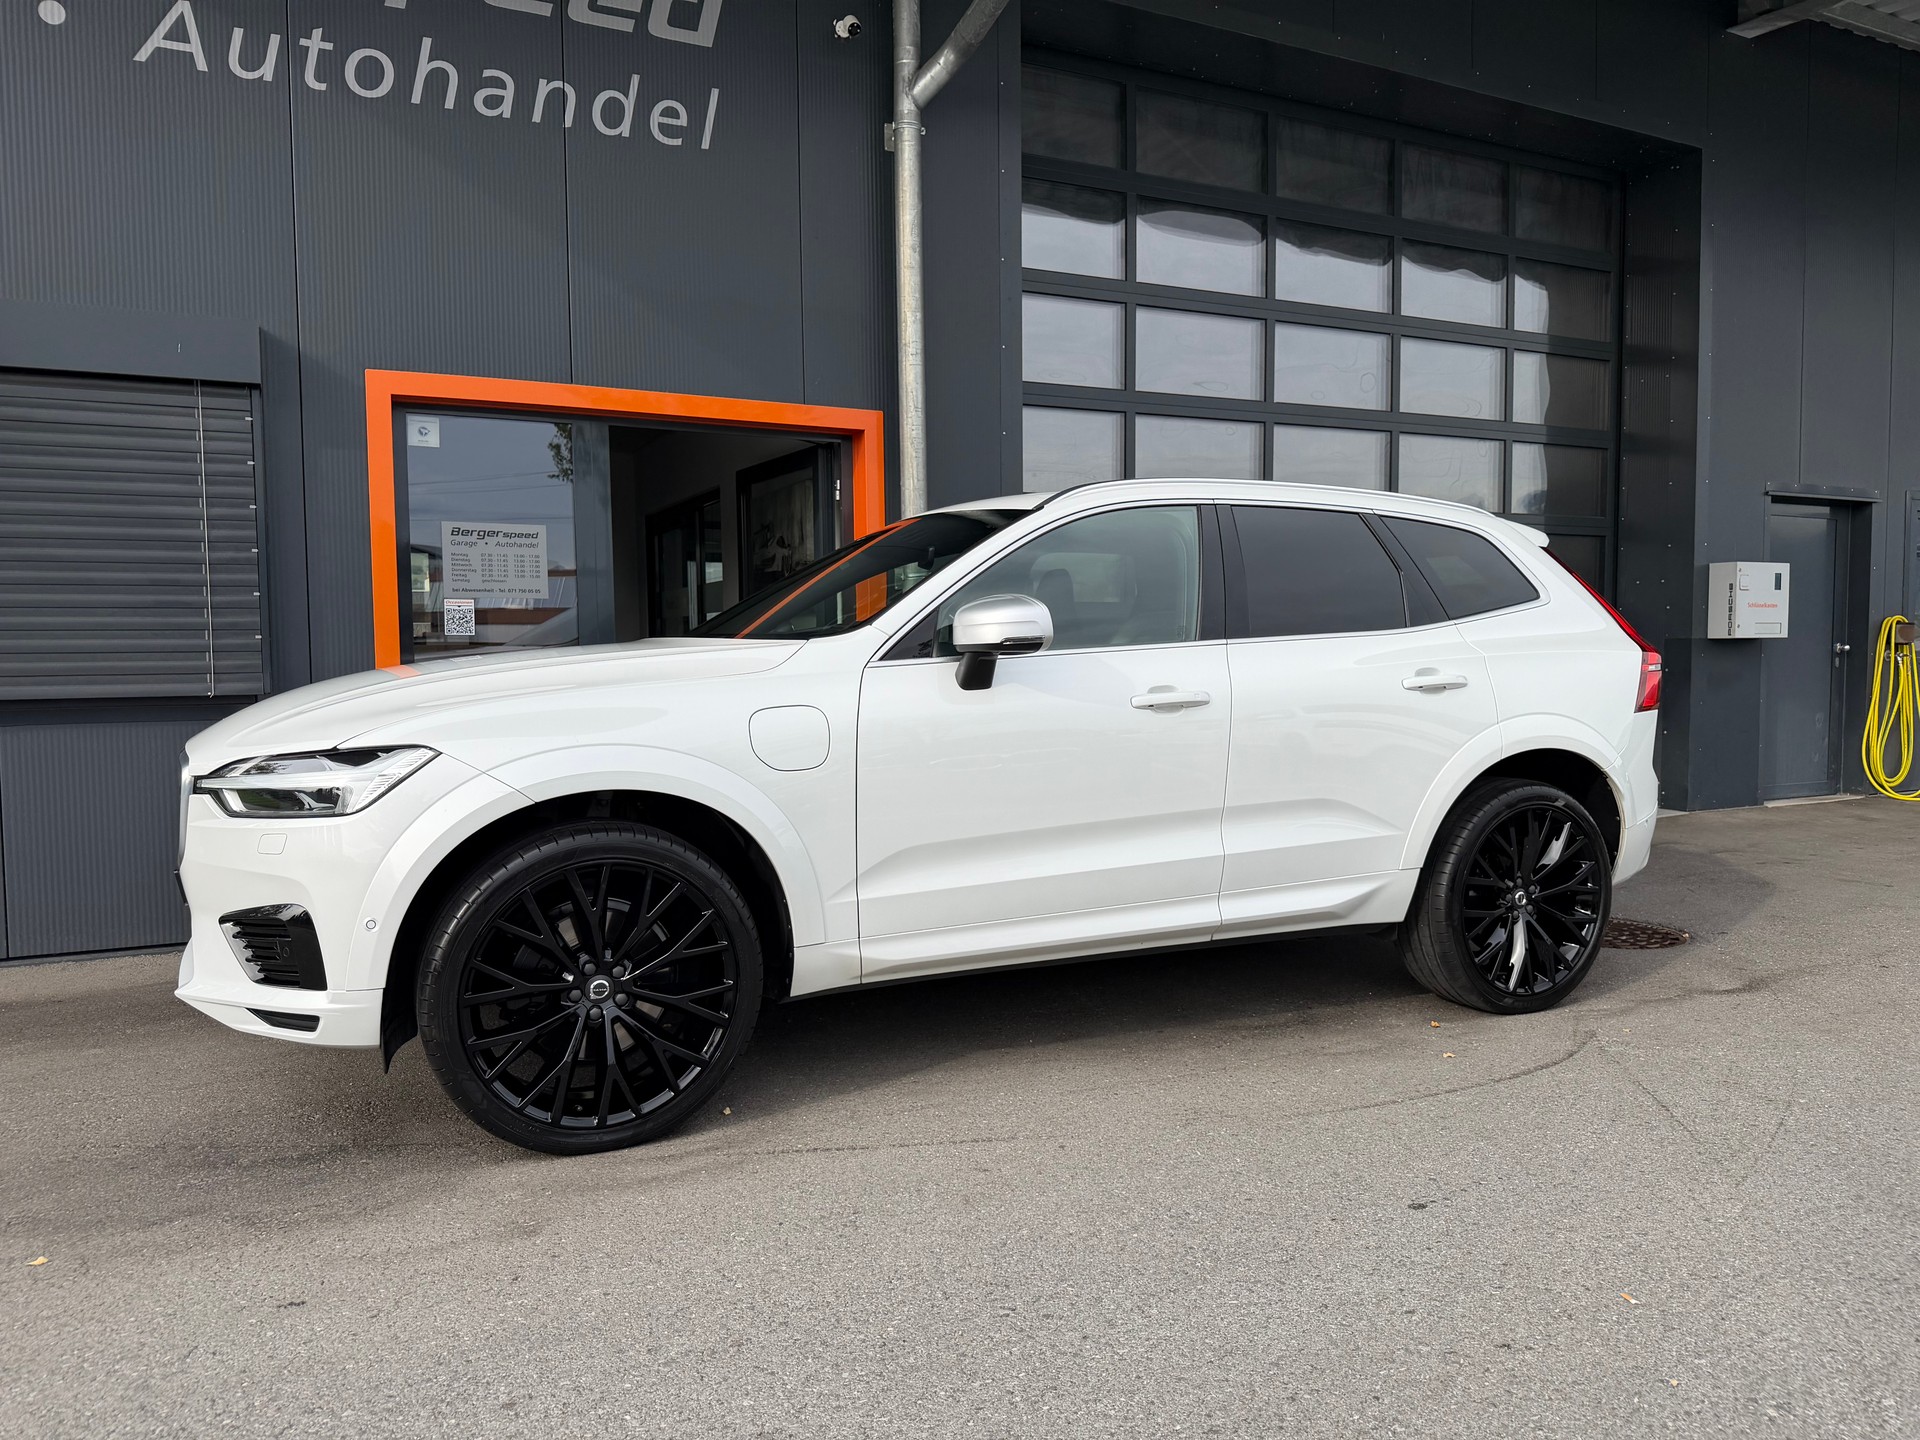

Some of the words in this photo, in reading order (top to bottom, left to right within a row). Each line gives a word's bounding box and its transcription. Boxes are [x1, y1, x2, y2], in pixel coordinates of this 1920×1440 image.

[133, 0, 720, 150] Autohandel
[450, 527, 539, 540] Bergerspeed
[450, 539, 478, 548] Garage
